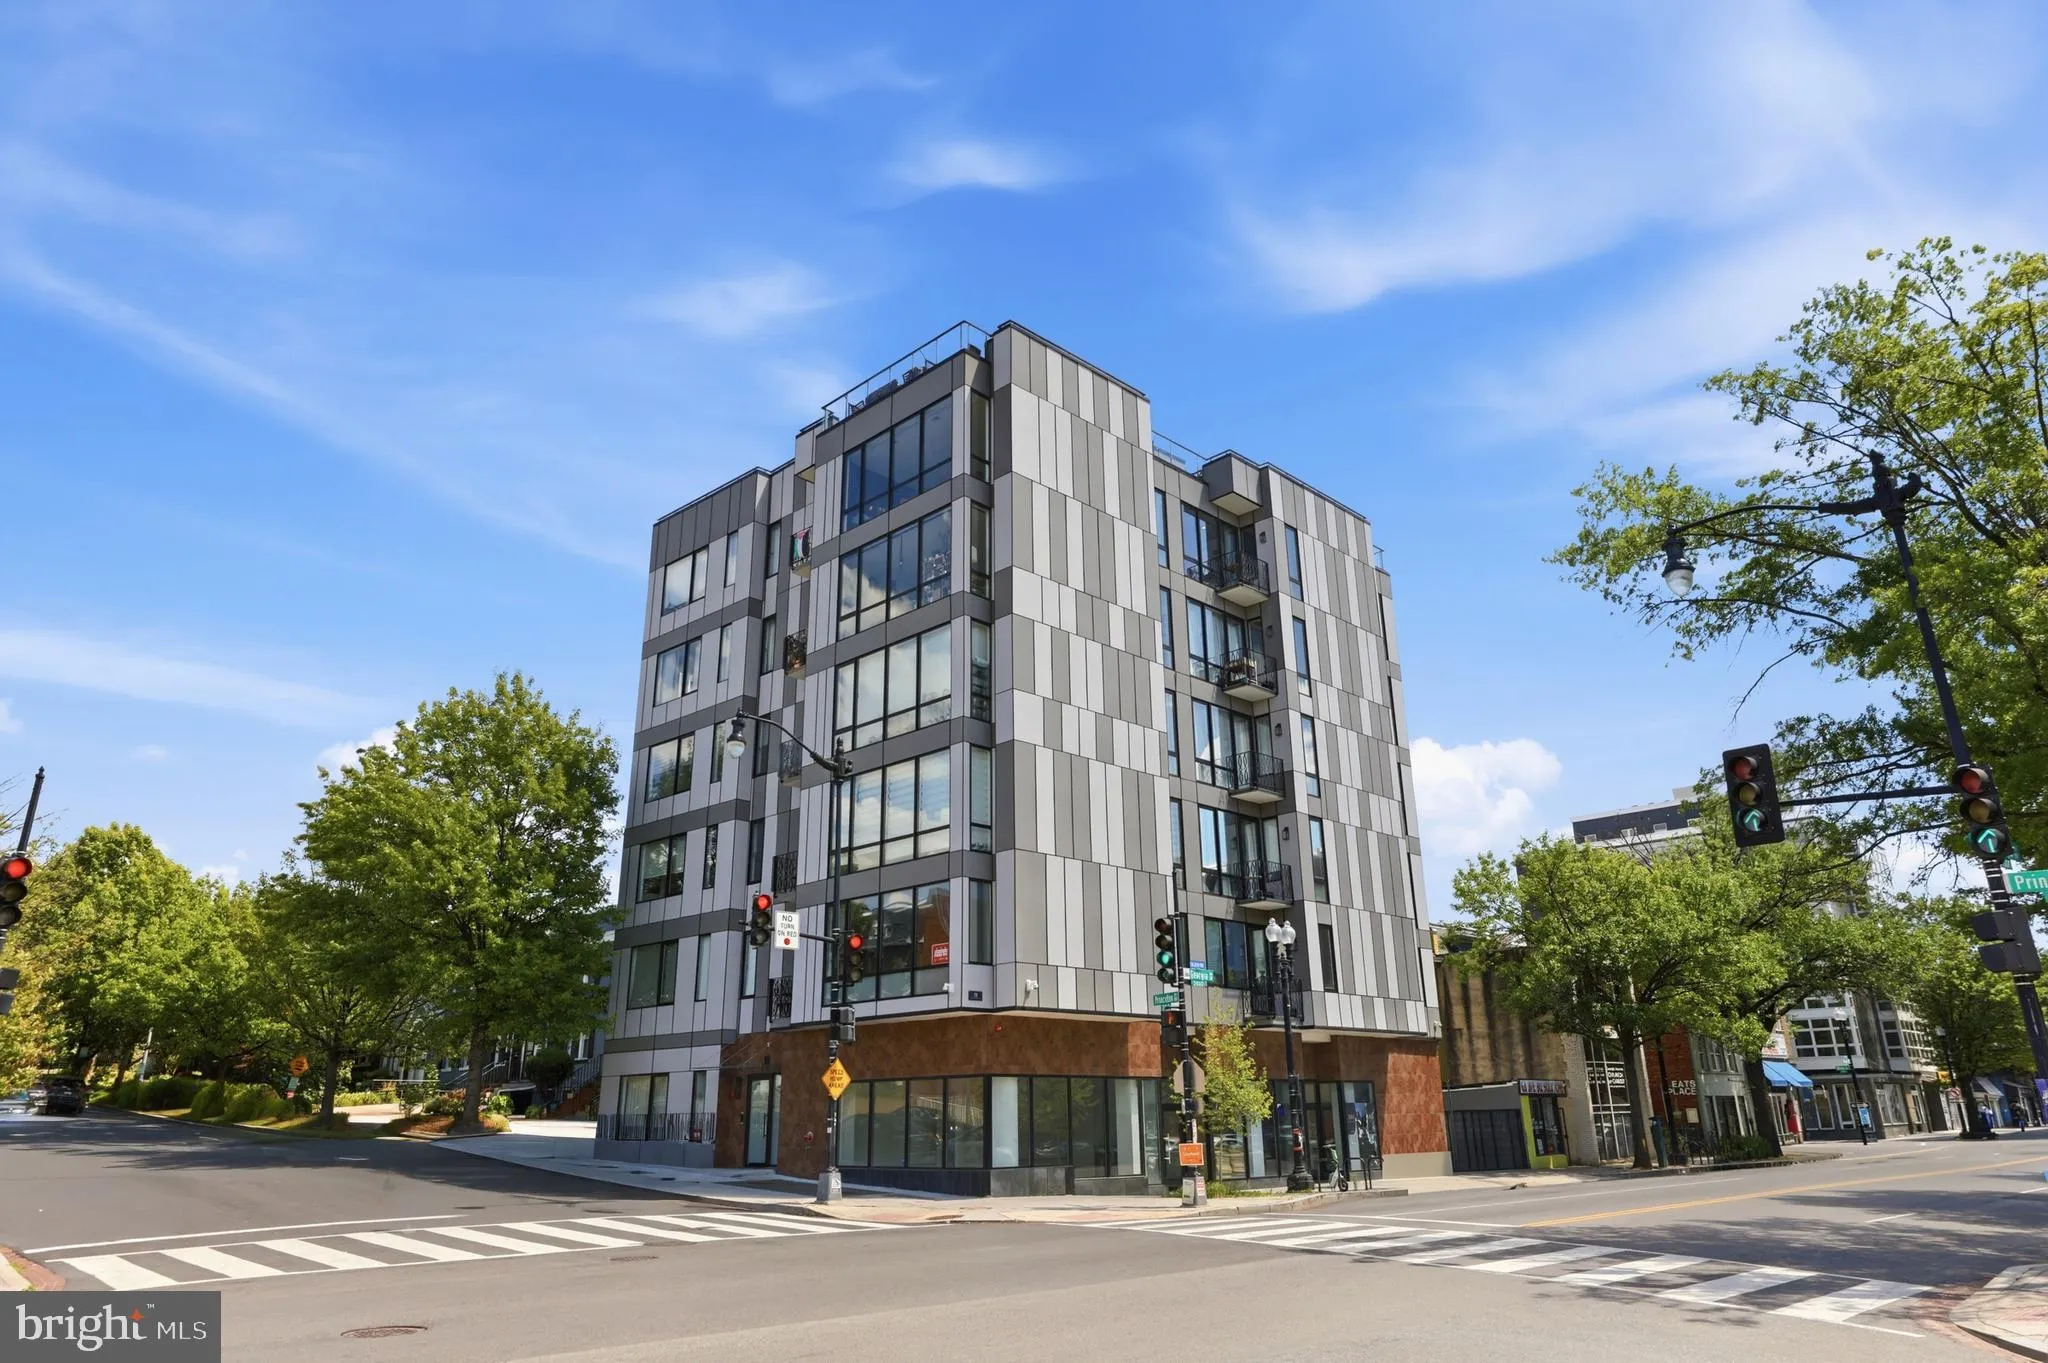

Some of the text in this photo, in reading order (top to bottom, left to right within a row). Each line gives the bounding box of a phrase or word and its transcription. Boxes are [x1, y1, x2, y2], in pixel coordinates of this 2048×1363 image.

[2014, 875, 2048, 890] Prin
[781, 914, 793, 922] NO
[780, 922, 795, 930] TURN
[1671, 1080, 1697, 1088] EATS
